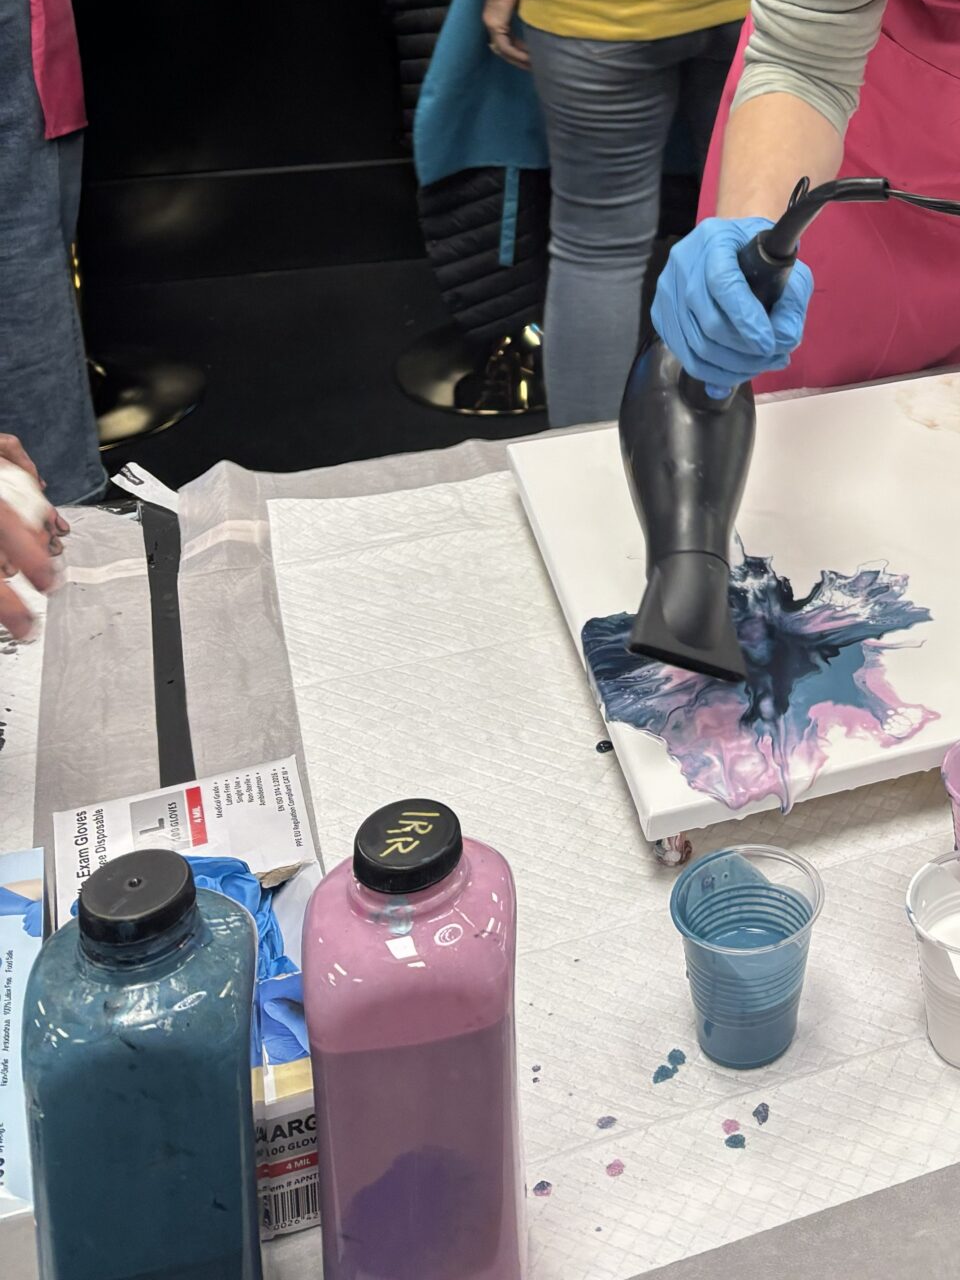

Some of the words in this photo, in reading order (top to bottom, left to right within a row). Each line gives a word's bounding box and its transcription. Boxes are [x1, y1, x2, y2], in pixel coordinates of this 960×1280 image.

[212, 784, 221, 799] Grade
[225, 792, 233, 806] Latex
[235, 790, 244, 804] Single
[244, 778, 254, 803] Non-Sterile
[256, 775, 266, 806] Ambidextrous
[285, 784, 295, 807] Compliant
[167, 801, 179, 827] GLOVES
[214, 799, 223, 818] Medical
[290, 807, 301, 830] Regulation
[74, 810, 89, 847] Gloves
[92, 808, 108, 855] Disposable
[139, 818, 165, 835] L
[76, 847, 91, 879] Exam
[269, 1113, 317, 1144] ARG
[285, 1162, 292, 1170] 4
[294, 1157, 311, 1169] MIL
